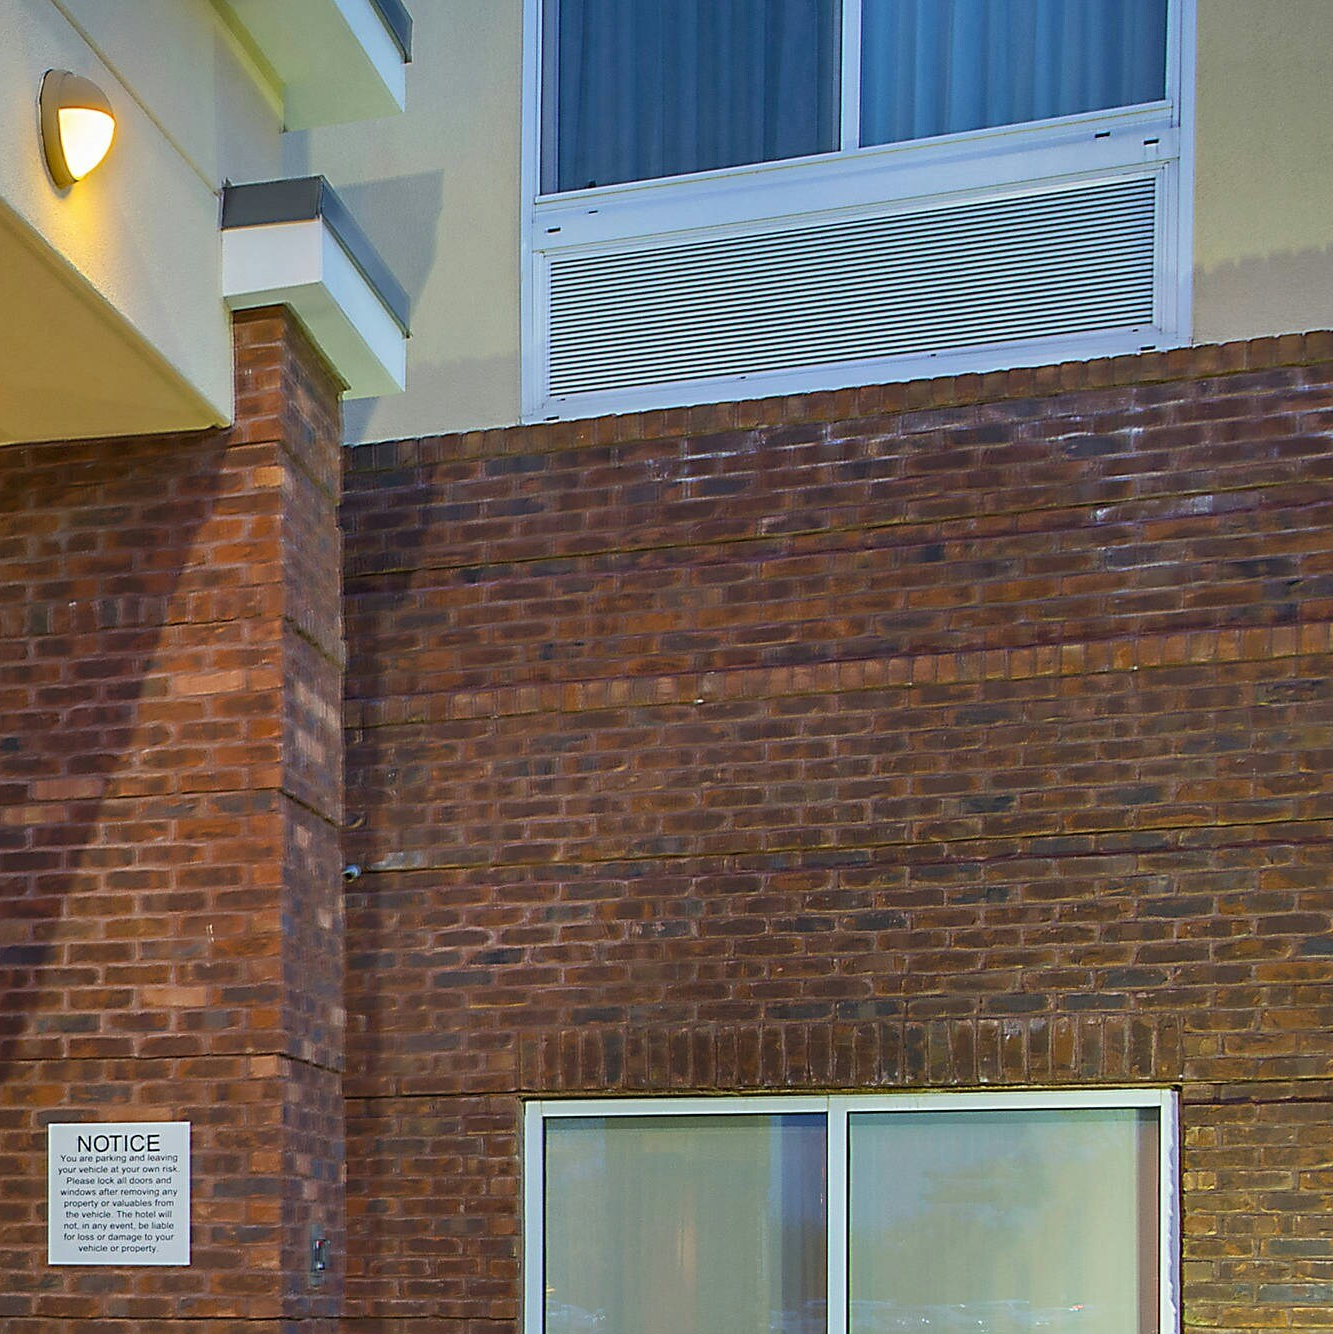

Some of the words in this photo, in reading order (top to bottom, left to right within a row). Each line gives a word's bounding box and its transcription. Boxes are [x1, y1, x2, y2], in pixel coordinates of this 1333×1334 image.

[77, 1134, 161, 1152] NOTICE
[95, 1155, 127, 1163] parking
[147, 1154, 178, 1163] leaving
[58, 1167, 76, 1175] your
[60, 1188, 96, 1196] windows
[120, 1189, 160, 1197] removing
[162, 1189, 178, 1197] any
[63, 1200, 98, 1208] property
[154, 1199, 174, 1207] from
[116, 1210, 133, 1218] The
[92, 1223, 107, 1231] any
[77, 1233, 95, 1241] loss
[107, 1234, 142, 1242] damage
[155, 1234, 174, 1242] your
